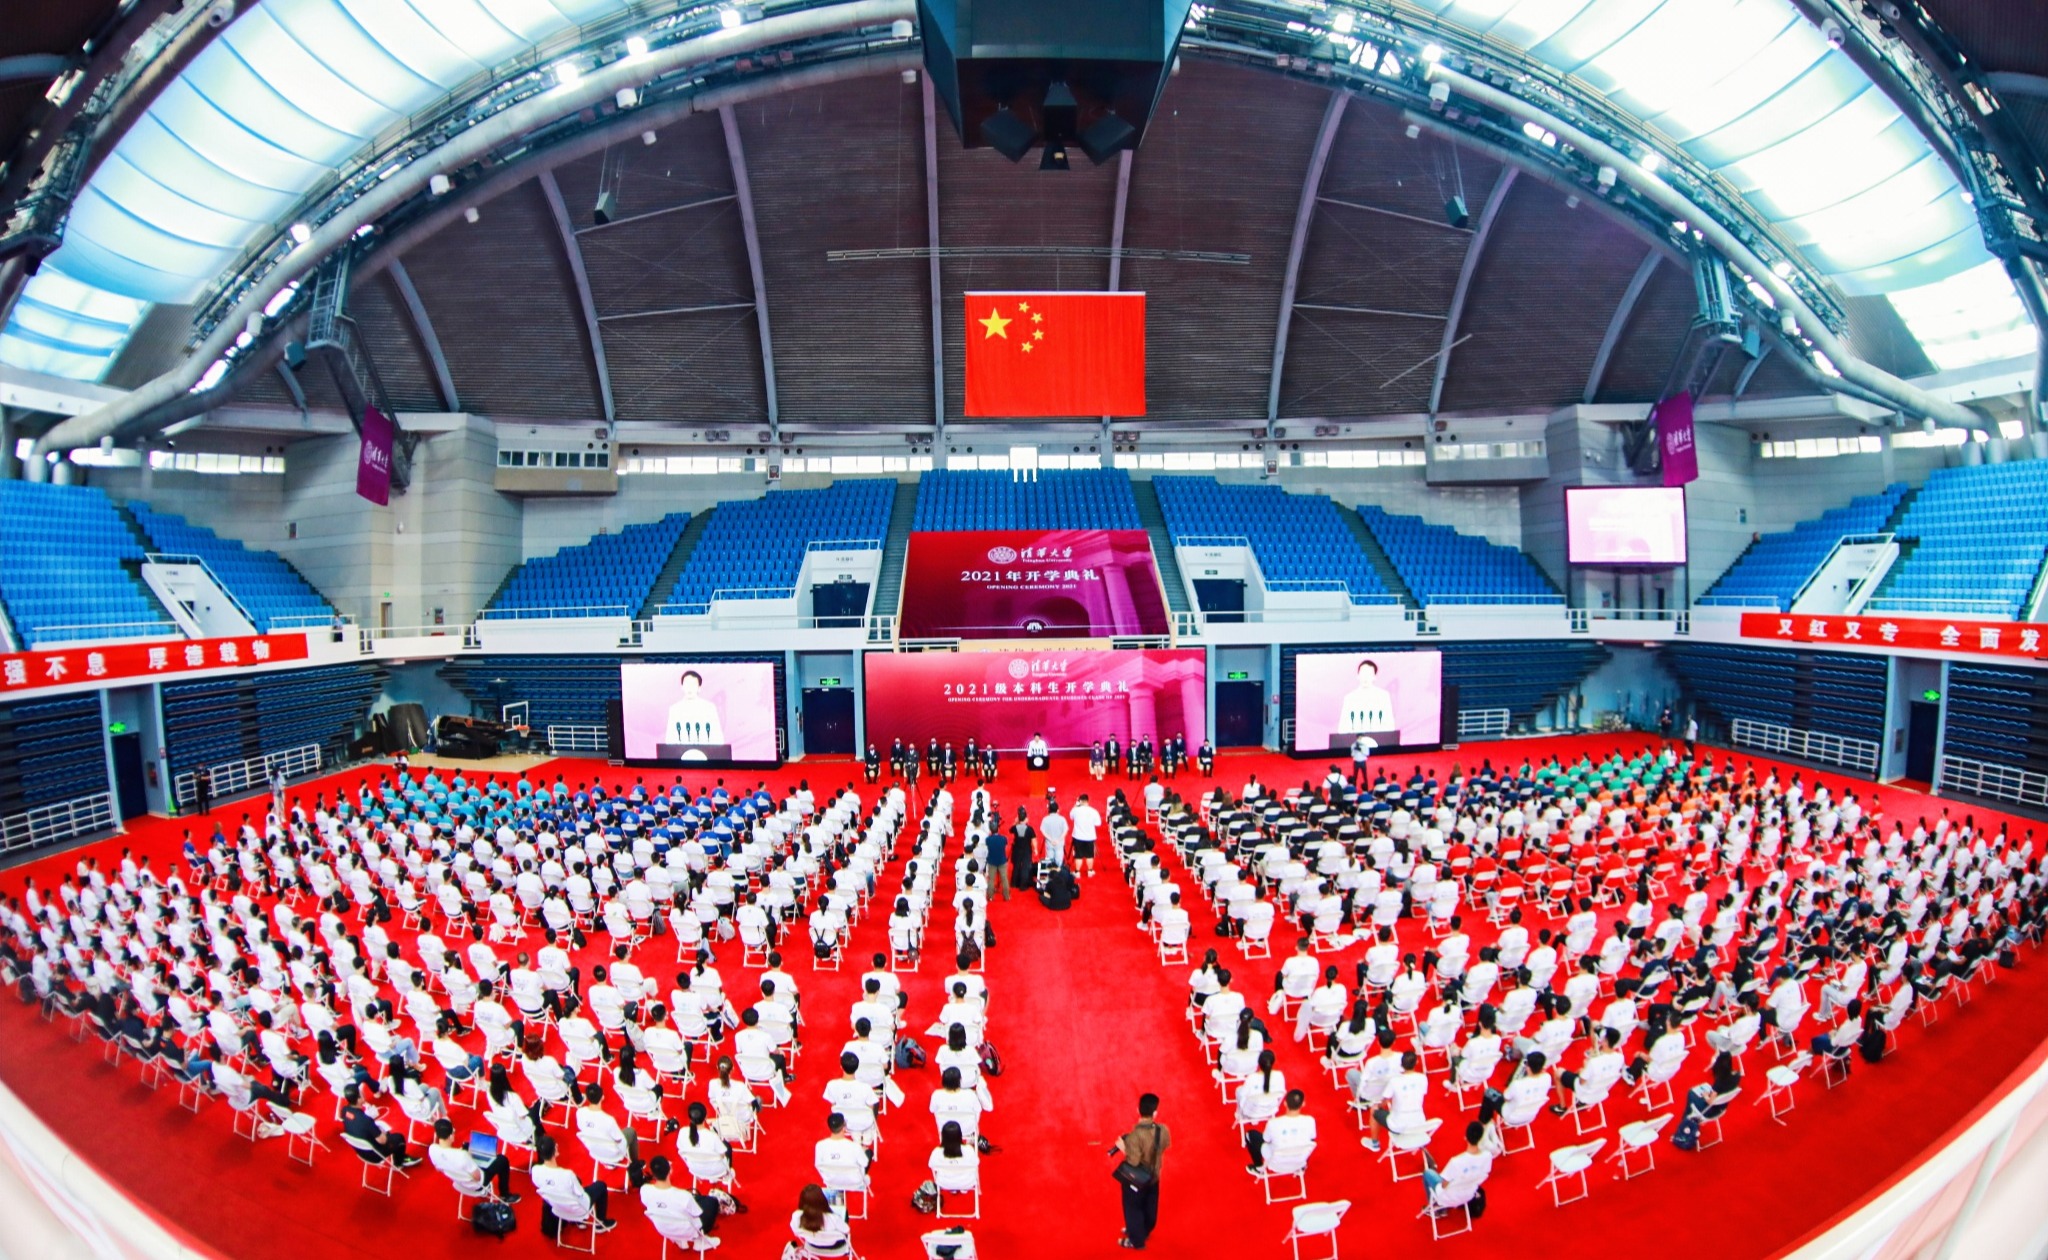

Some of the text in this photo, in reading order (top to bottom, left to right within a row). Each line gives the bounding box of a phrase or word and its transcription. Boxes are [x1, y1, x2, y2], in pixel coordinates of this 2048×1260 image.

[960, 569, 1100, 582] 2021年开学典礼
[1777, 619, 2040, 652] 又红又专 全面发
[4, 640, 270, 685] 强不息 厚德载物
[943, 681, 1130, 695] 2021级本科生开学典礼
